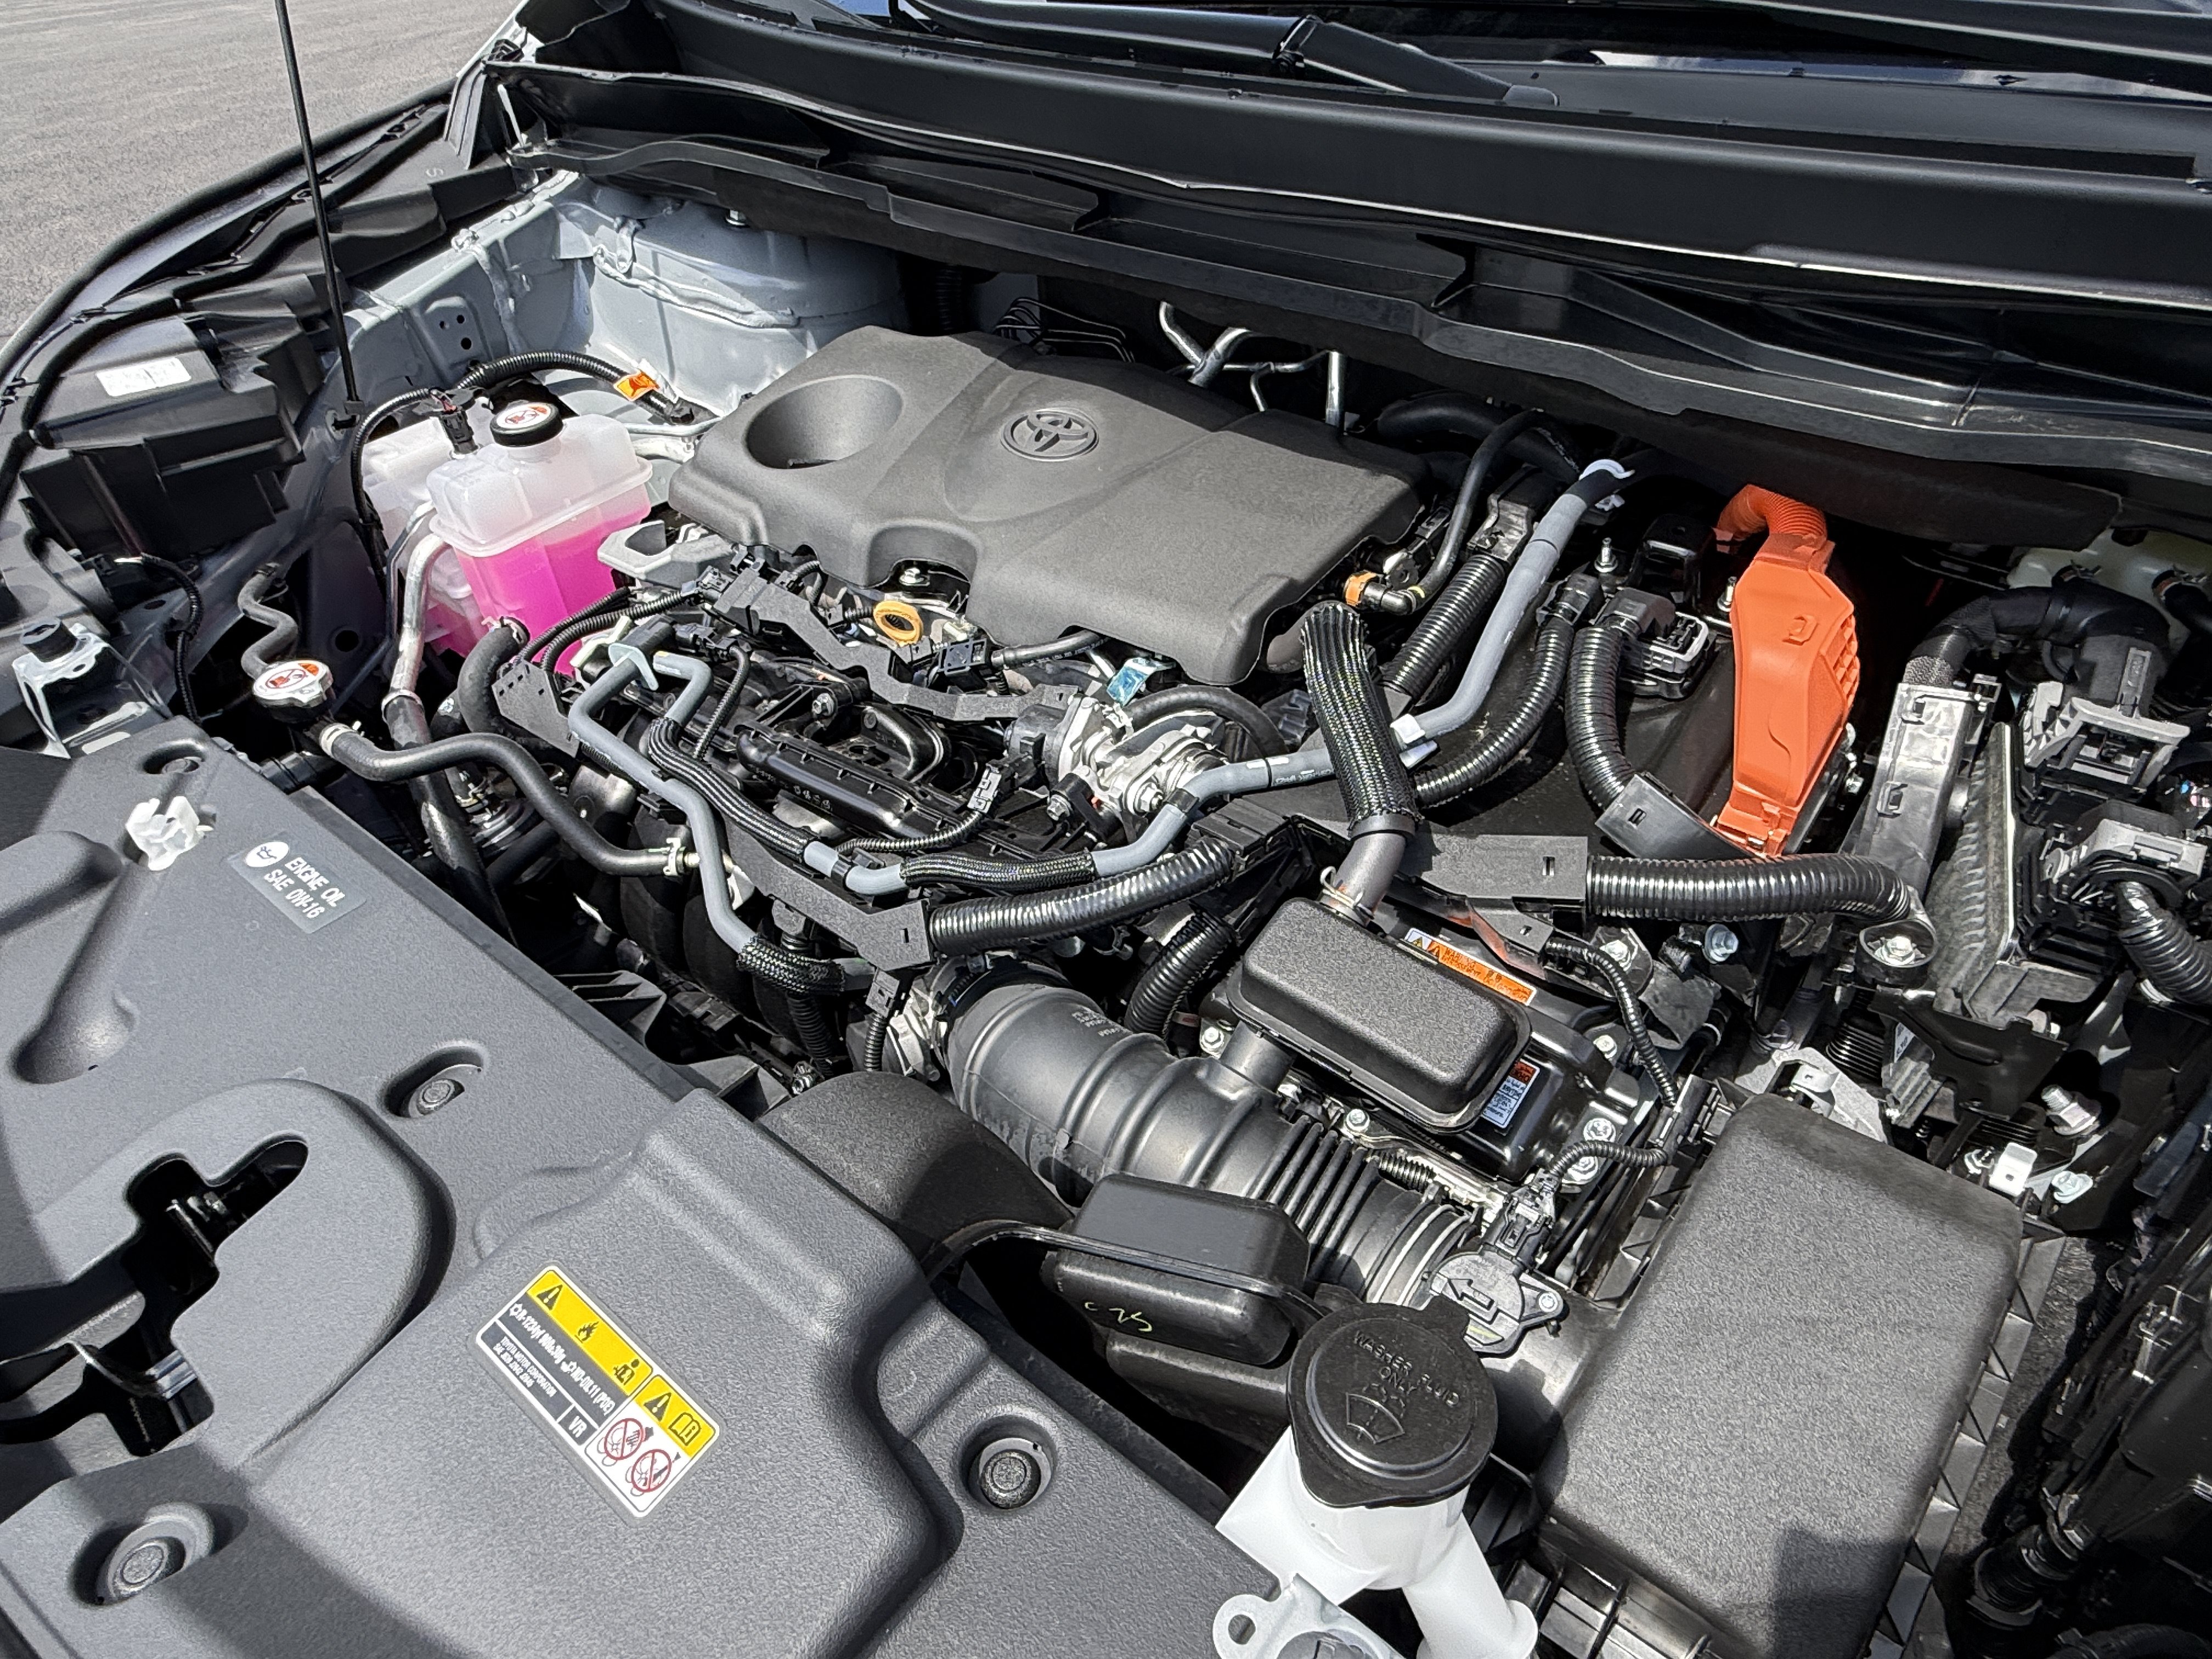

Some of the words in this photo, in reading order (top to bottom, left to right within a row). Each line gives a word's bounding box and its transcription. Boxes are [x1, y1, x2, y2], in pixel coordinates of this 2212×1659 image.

[263, 870, 295, 891] SAE
[285, 889, 325, 918] 0W-16
[285, 857, 329, 891] ENGINE
[321, 888, 345, 907] OIL
[499, 1336, 517, 1355] TOYOTA
[514, 1351, 531, 1369] MOTOR
[528, 1365, 557, 1397] CORPORATION
[1353, 1330, 1413, 1376] WASHER
[1417, 1373, 1459, 1407] FLUID
[1379, 1365, 1418, 1395] ONLY
[568, 1416, 587, 1438] VR
